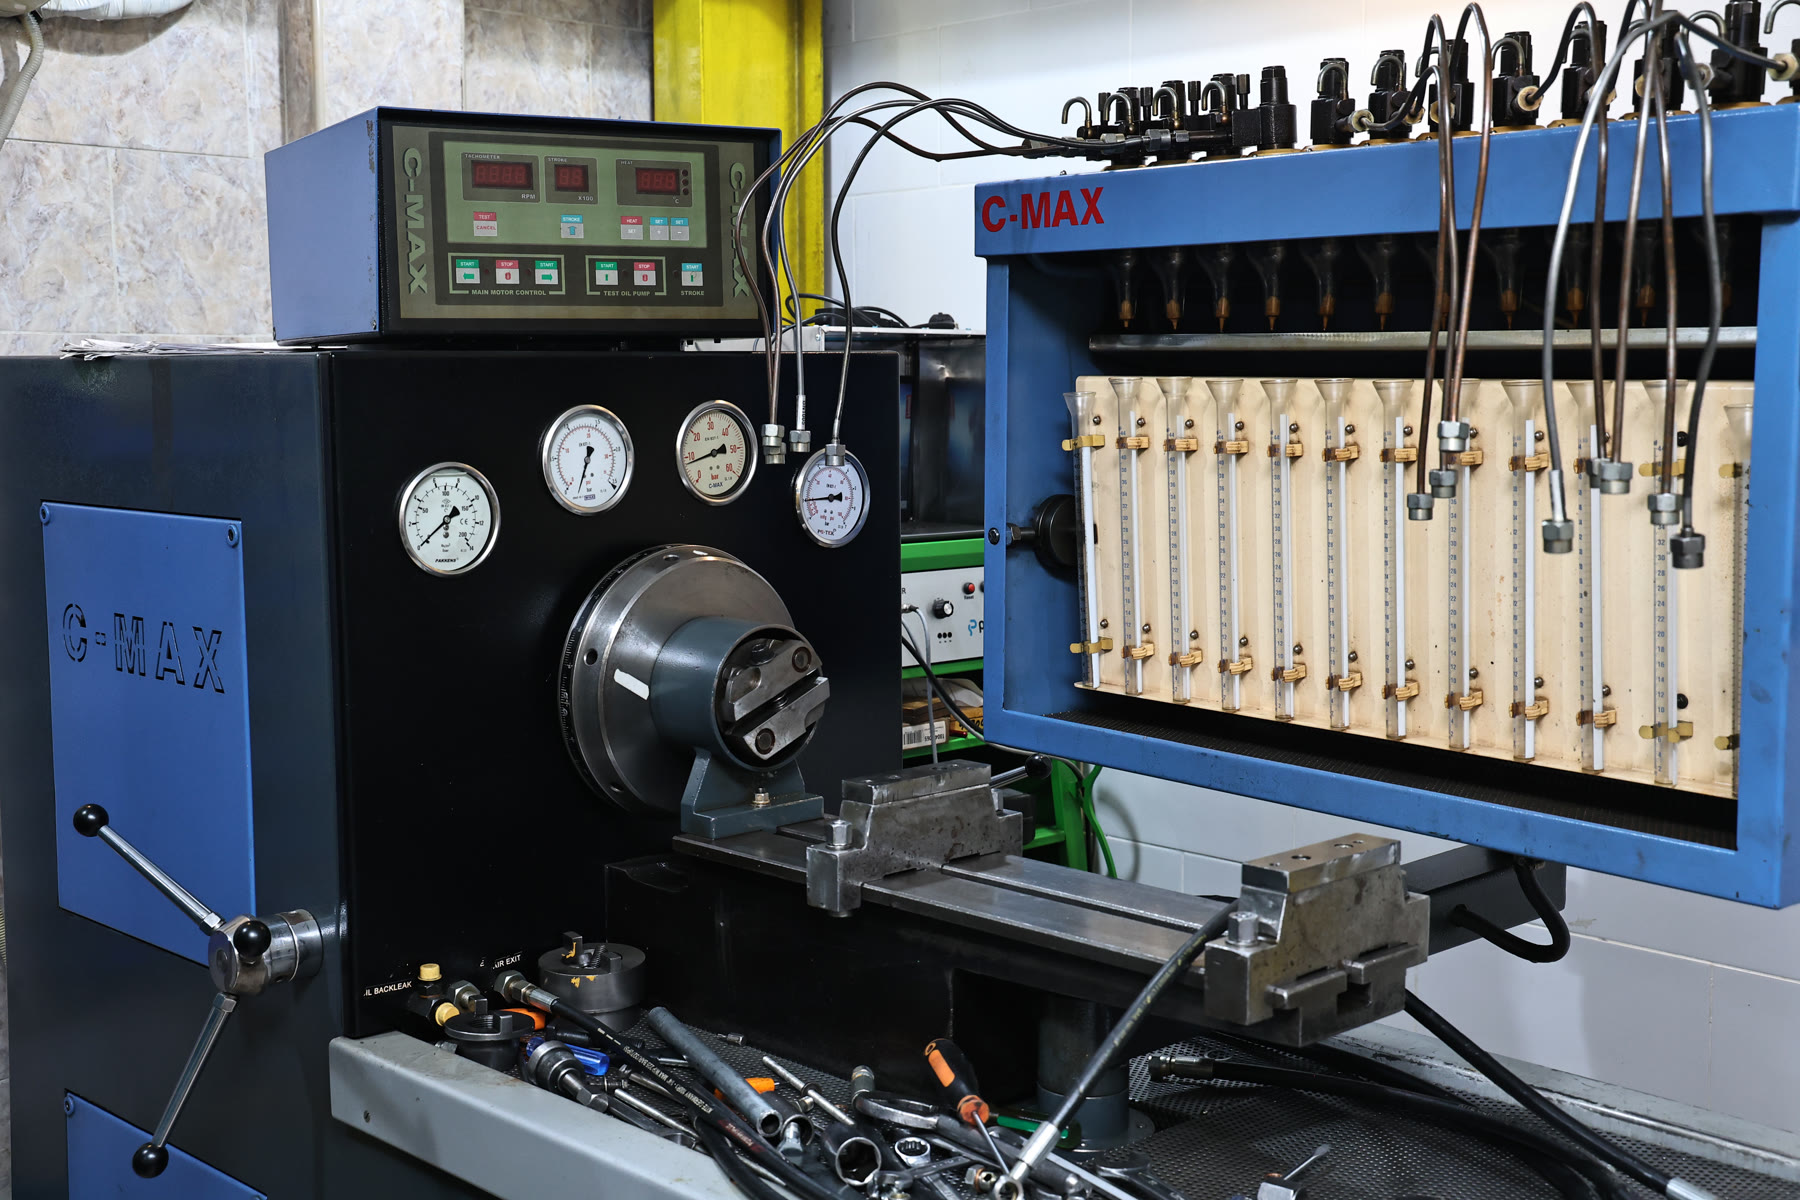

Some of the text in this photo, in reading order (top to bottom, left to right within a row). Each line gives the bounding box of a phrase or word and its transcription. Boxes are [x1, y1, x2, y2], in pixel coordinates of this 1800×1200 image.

[982, 186, 1104, 232] C-MAX
[403, 148, 428, 294] C-MAX
[707, 422, 714, 430] 30
[722, 428, 729, 436] 40
[694, 433, 700, 441] 20
[730, 444, 737, 453] 50
[688, 452, 695, 460] 10
[726, 463, 732, 472] 60
[698, 470, 701, 478] 0
[63, 604, 224, 694] C-MAX
[506, 954, 521, 965] EXIT
[374, 981, 412, 994] BACKLEAK
